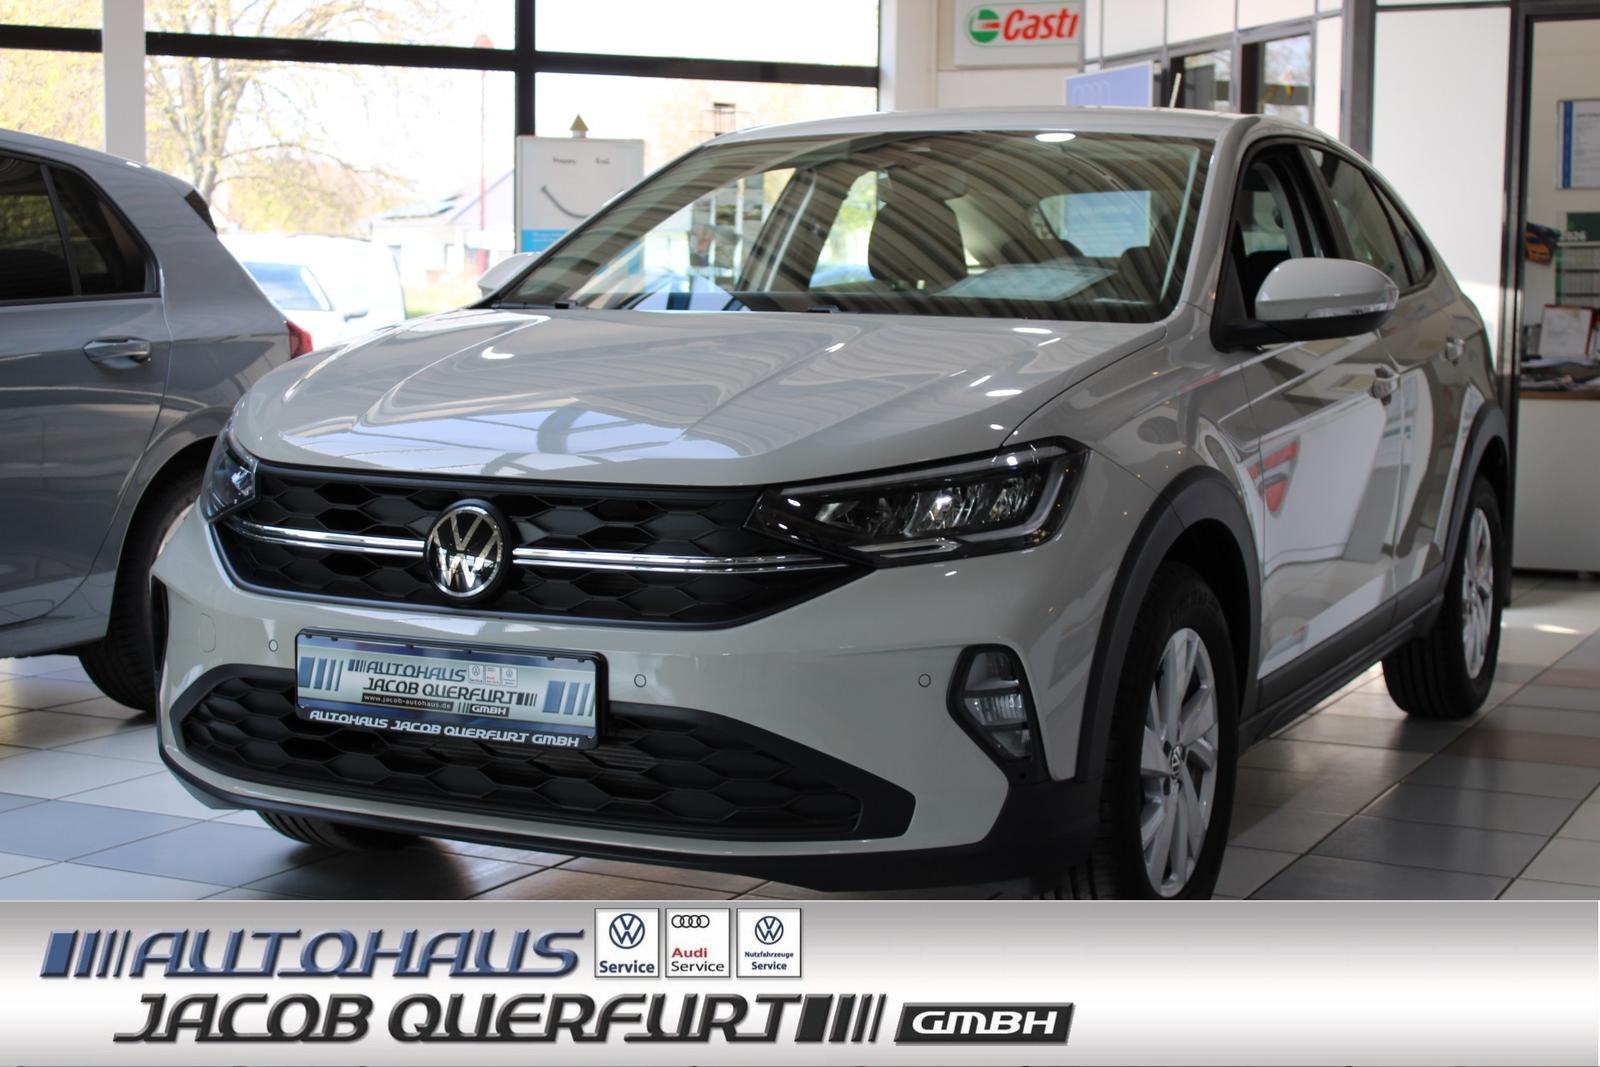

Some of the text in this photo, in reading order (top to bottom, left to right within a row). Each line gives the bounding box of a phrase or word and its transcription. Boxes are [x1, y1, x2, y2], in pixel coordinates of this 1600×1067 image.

[366, 660, 467, 682] AUTOHAUS
[363, 677, 518, 706] JACOB QUERFURT
[363, 694, 451, 709] www.jacob-autohaus.de
[471, 704, 507, 716] GMBH
[309, 709, 580, 748] AUTOHAUS JACOB QUERFURT GMBH
